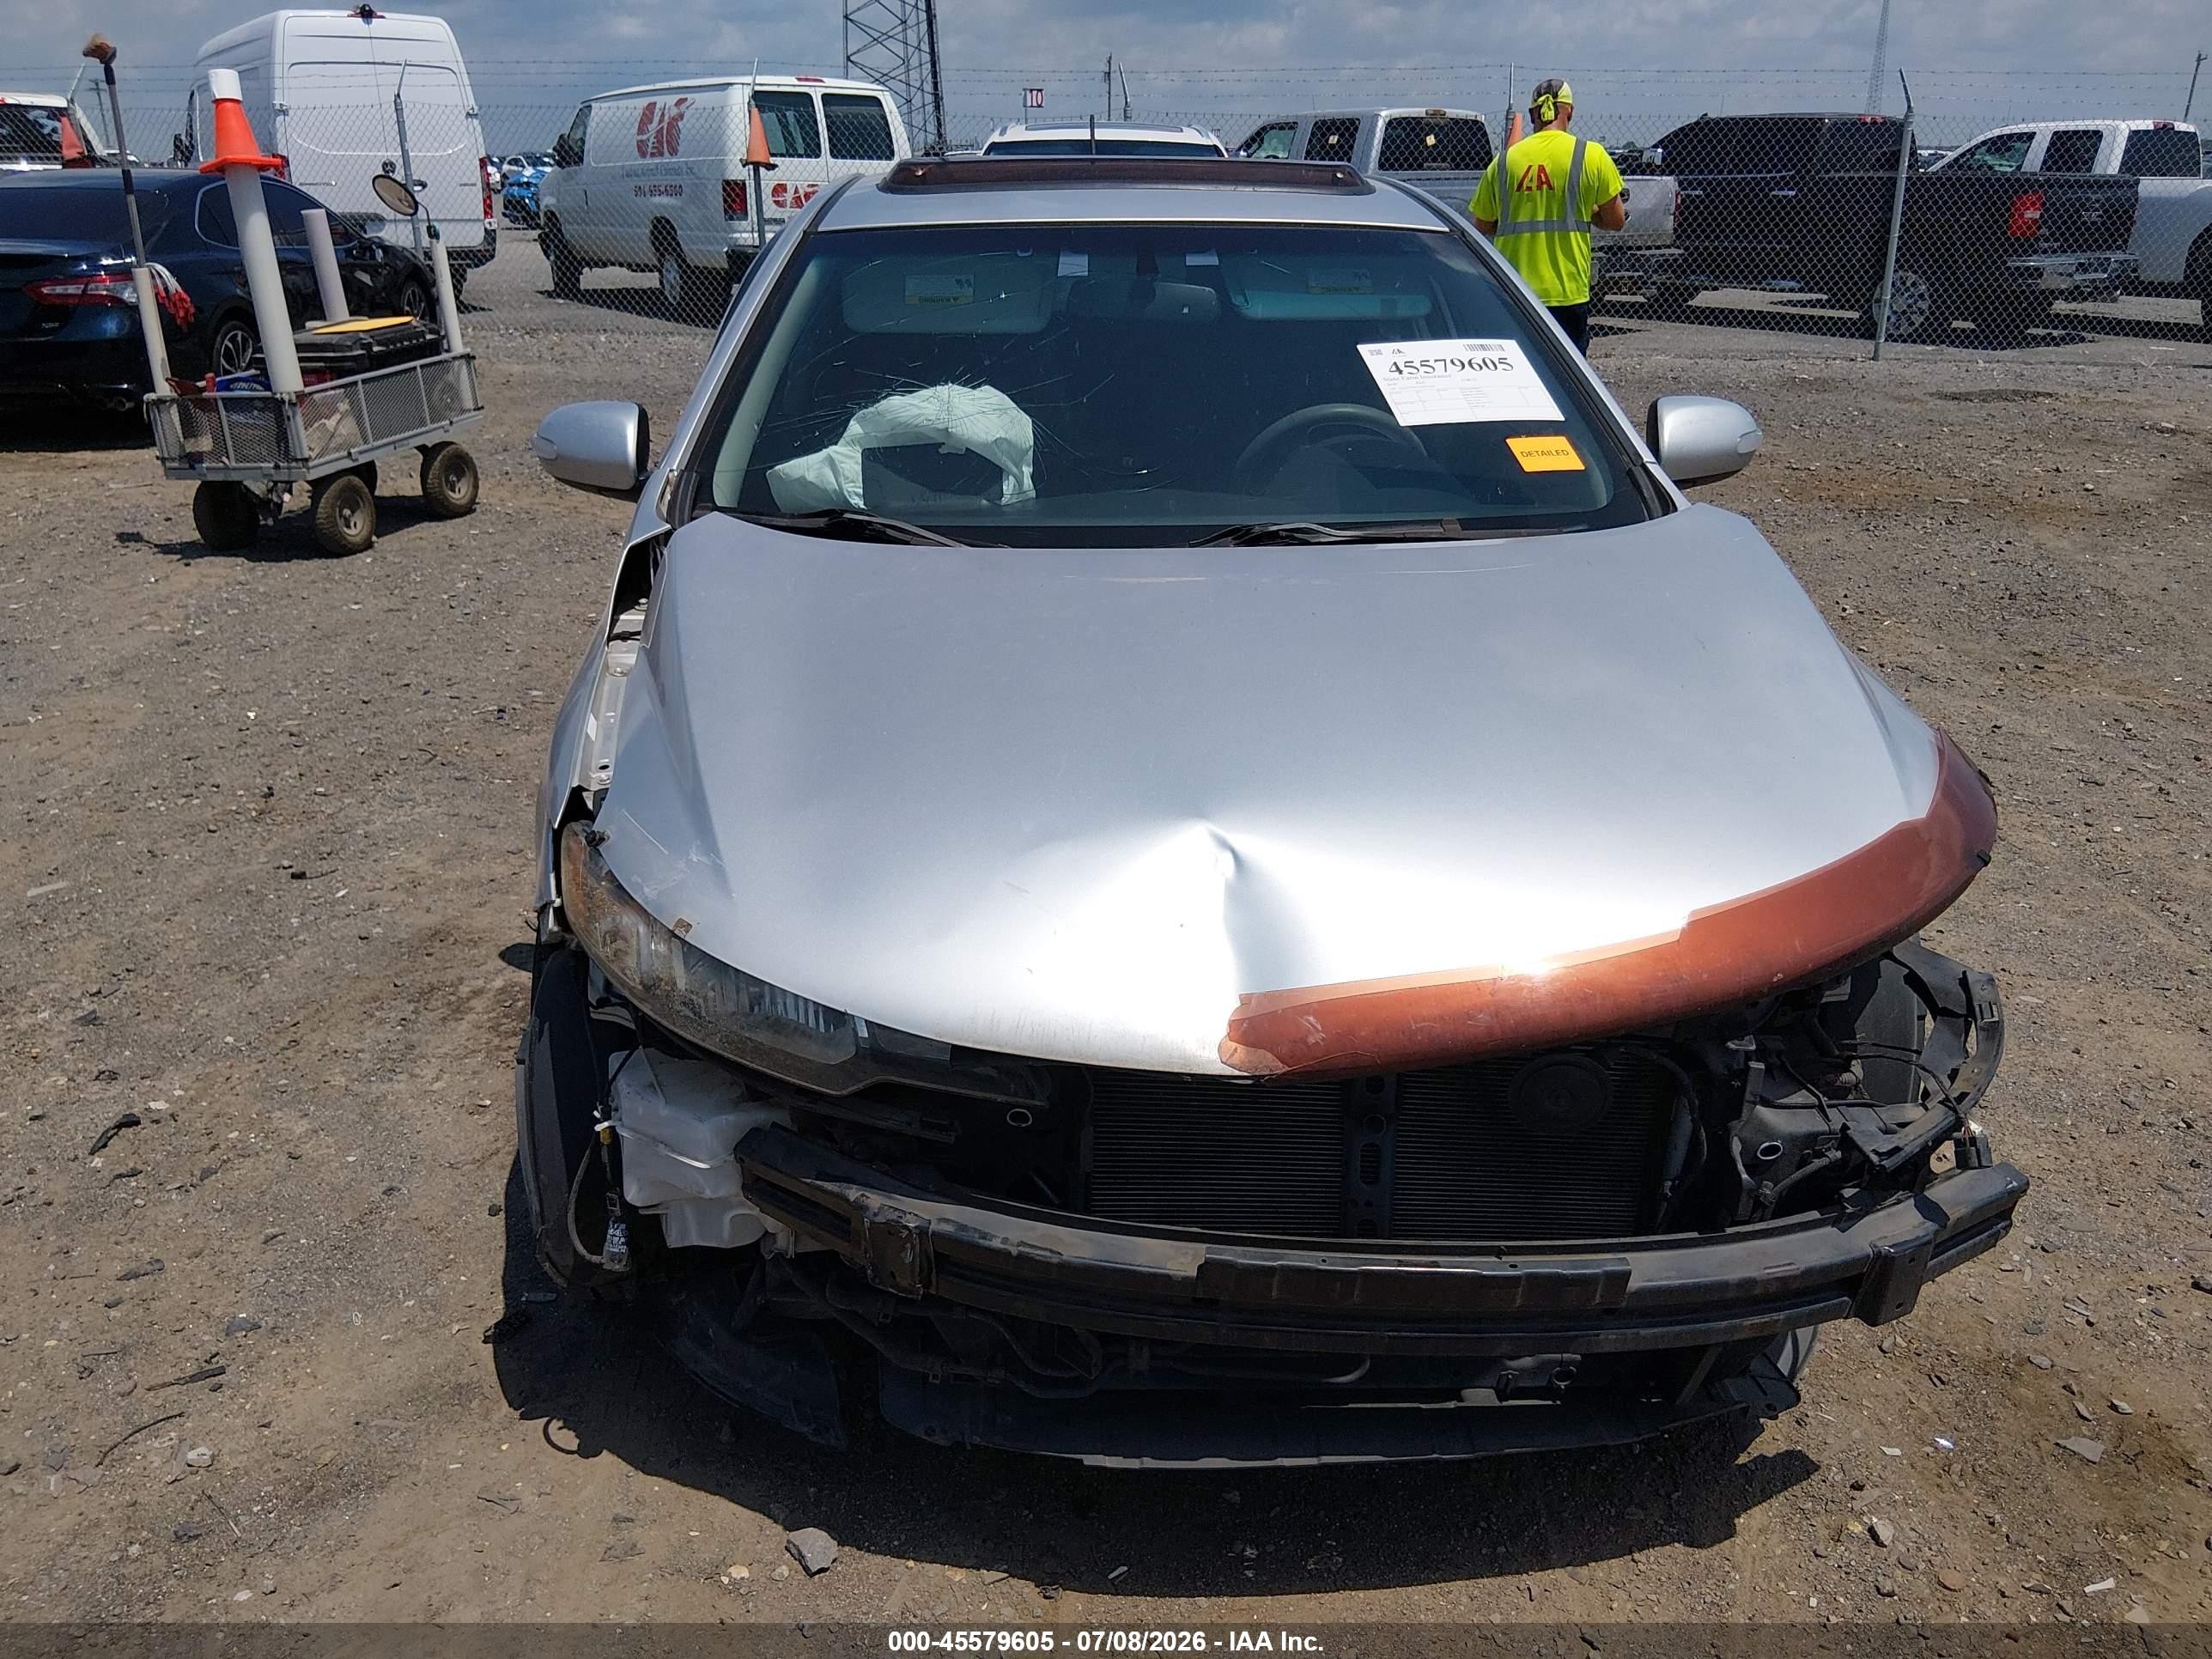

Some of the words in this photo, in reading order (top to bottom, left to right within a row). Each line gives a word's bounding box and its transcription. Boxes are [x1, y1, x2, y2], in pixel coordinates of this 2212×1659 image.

[1030, 88, 1043, 107] 10
[1389, 357, 1514, 376] 45579605
[1520, 449, 1570, 458] DETAILED
